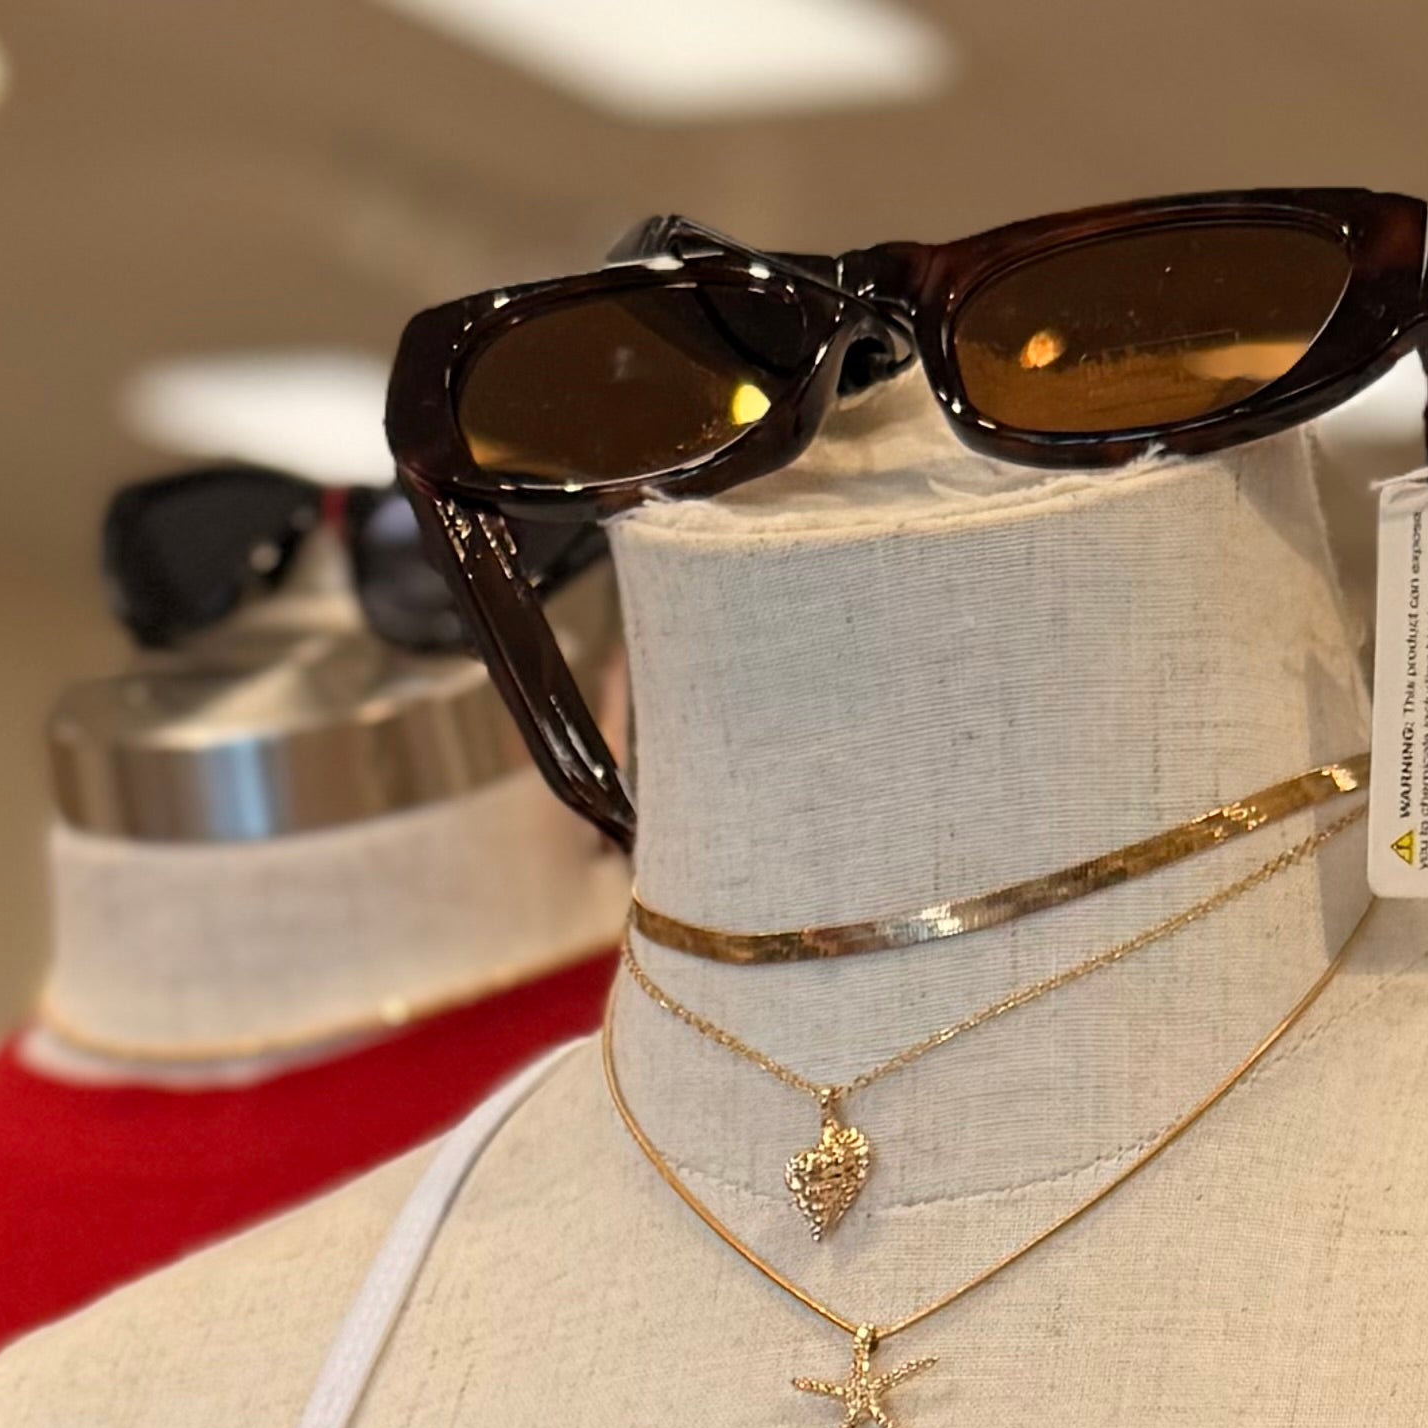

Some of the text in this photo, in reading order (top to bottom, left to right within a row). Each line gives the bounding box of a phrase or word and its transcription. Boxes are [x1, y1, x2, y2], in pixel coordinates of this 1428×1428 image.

[1409, 577, 1420, 609] can
[1405, 613, 1420, 677] product
[1403, 680, 1416, 714] This
[1400, 722, 1415, 818] WARNING:
